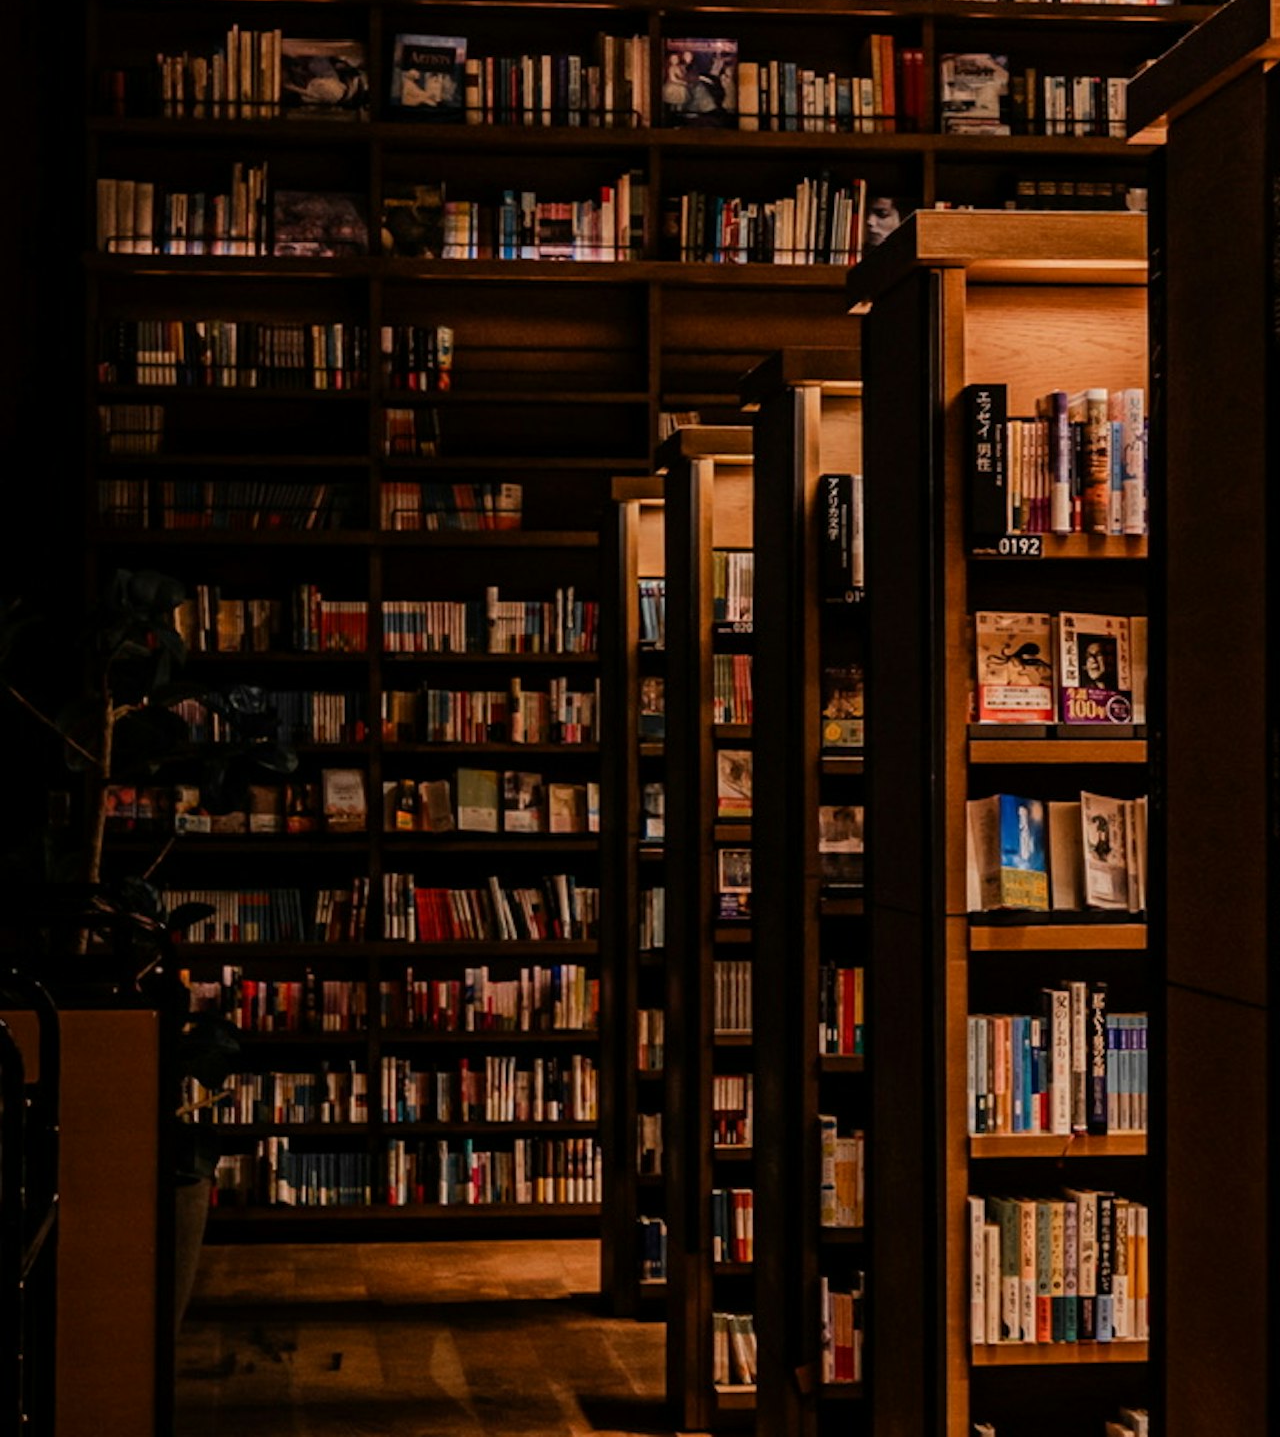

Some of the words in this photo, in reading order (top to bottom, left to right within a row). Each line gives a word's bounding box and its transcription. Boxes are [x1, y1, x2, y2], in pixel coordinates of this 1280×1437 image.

[976, 392, 992, 440] エッセイ
[976, 443, 993, 472] 男性
[998, 538, 1041, 554] 0192
